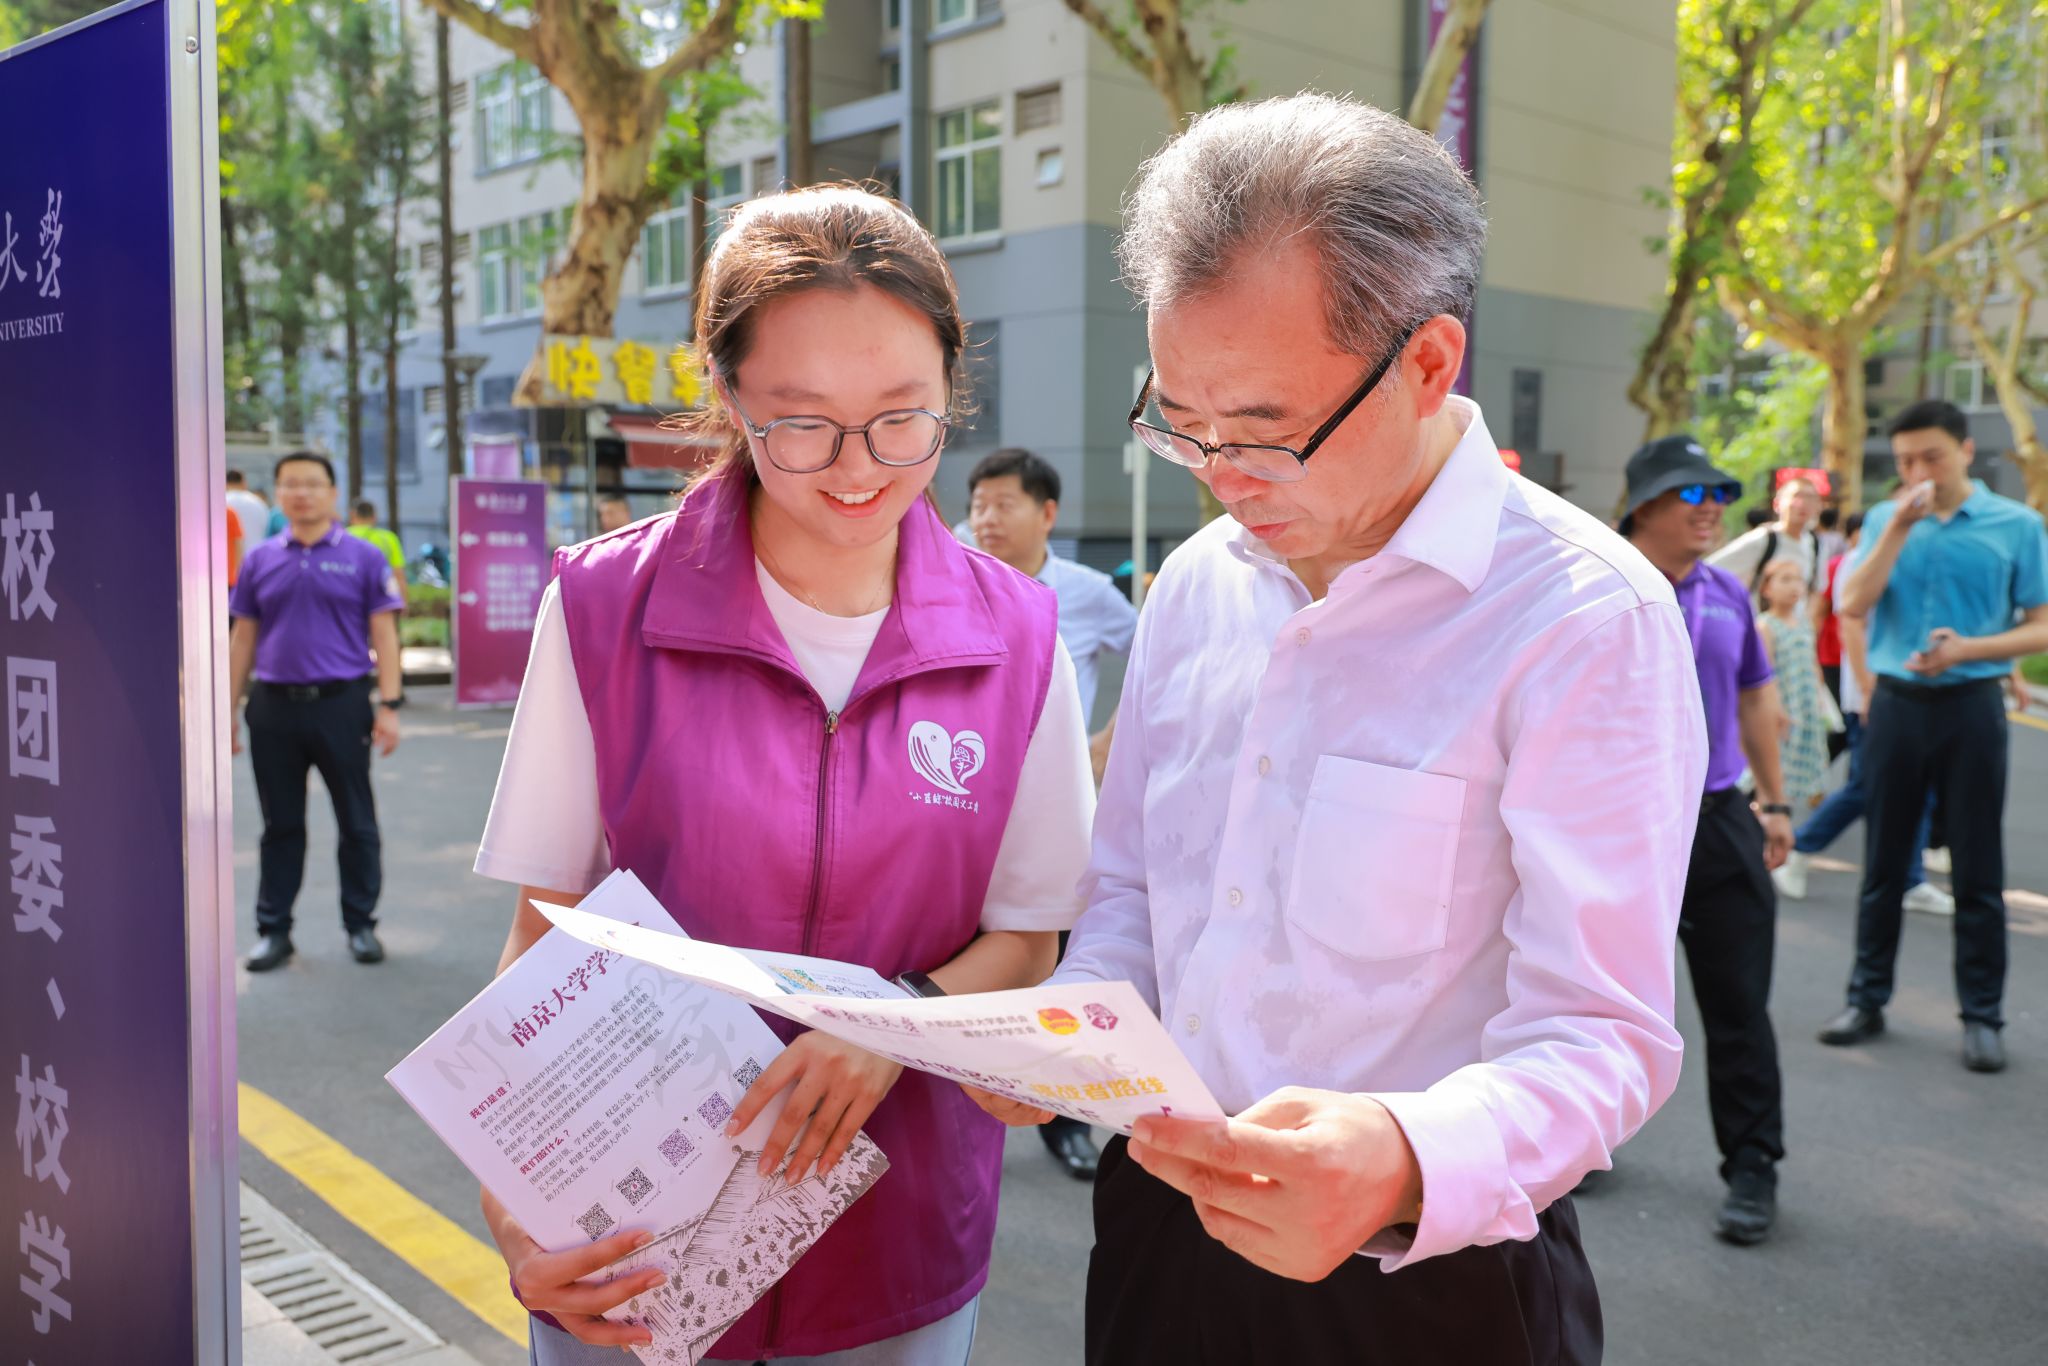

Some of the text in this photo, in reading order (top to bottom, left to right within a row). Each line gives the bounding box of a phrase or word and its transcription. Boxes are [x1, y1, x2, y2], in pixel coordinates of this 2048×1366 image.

[1, 491, 73, 1366] 校团委、校学
[508, 922, 641, 1048] 南京大学学
[468, 1079, 513, 1120] 我们是谁？
[519, 1128, 571, 1176] 我们做什么？
